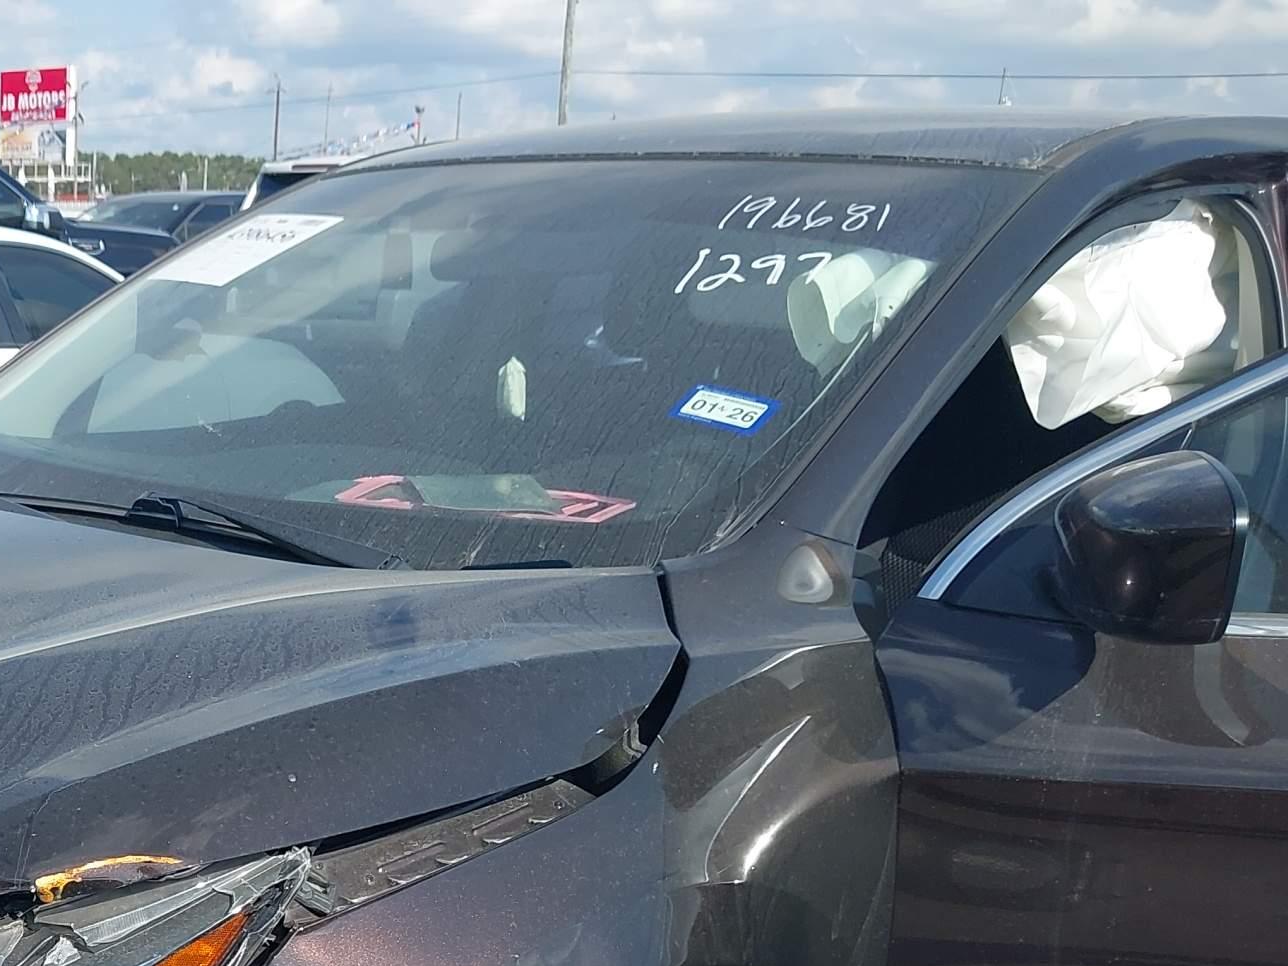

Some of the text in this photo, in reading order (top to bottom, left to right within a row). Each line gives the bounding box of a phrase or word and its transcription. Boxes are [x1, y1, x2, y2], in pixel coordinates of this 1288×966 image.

[1, 89, 66, 112] JD MOTORS
[718, 194, 891, 232] 196681
[673, 248, 833, 294] 1297
[690, 398, 719, 414] 01
[726, 407, 758, 423] 26
